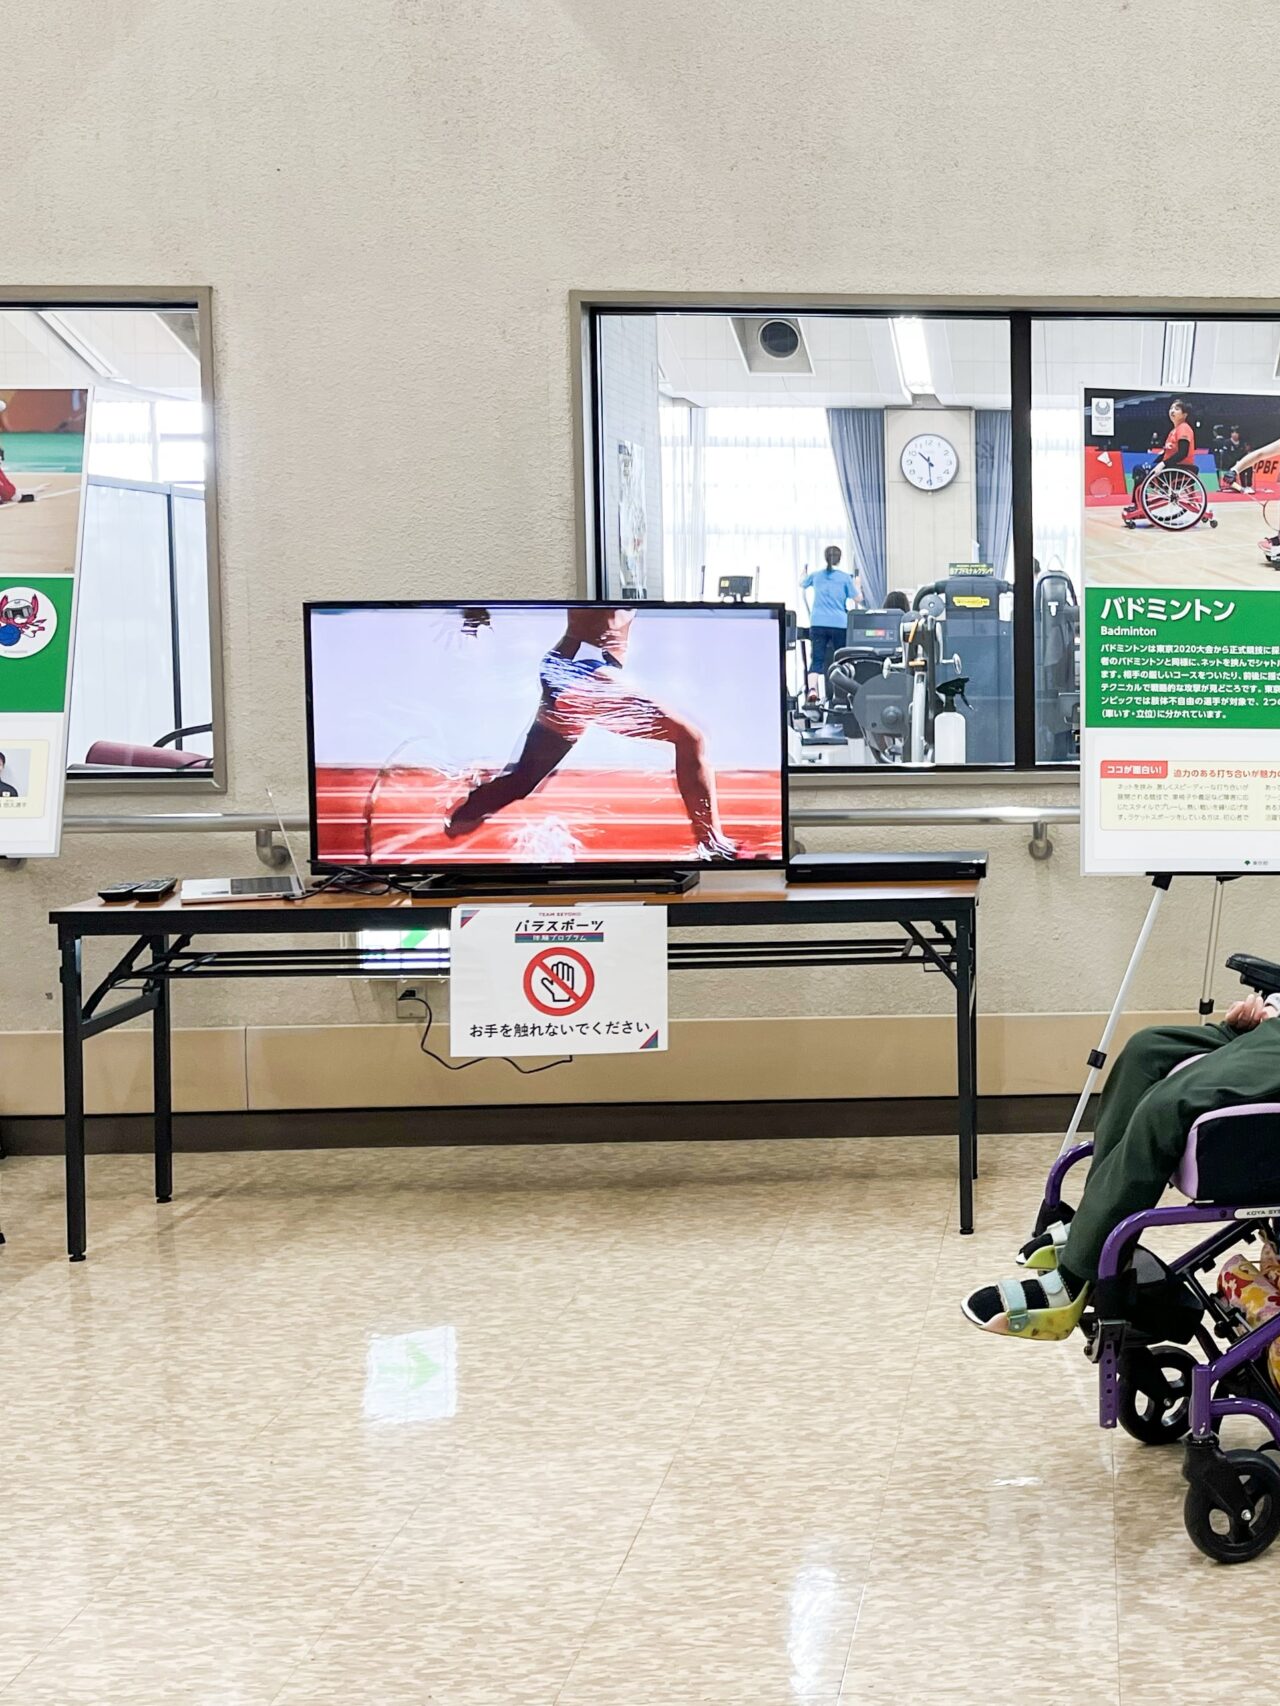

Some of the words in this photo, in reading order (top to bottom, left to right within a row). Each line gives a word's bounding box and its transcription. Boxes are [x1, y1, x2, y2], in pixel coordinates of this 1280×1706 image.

[1100, 595, 1236, 622] バドミントン
[1100, 626, 1157, 637] Badminton
[515, 918, 604, 932] パラスポーツ
[469, 1021, 650, 1039] お手を触れないでください
